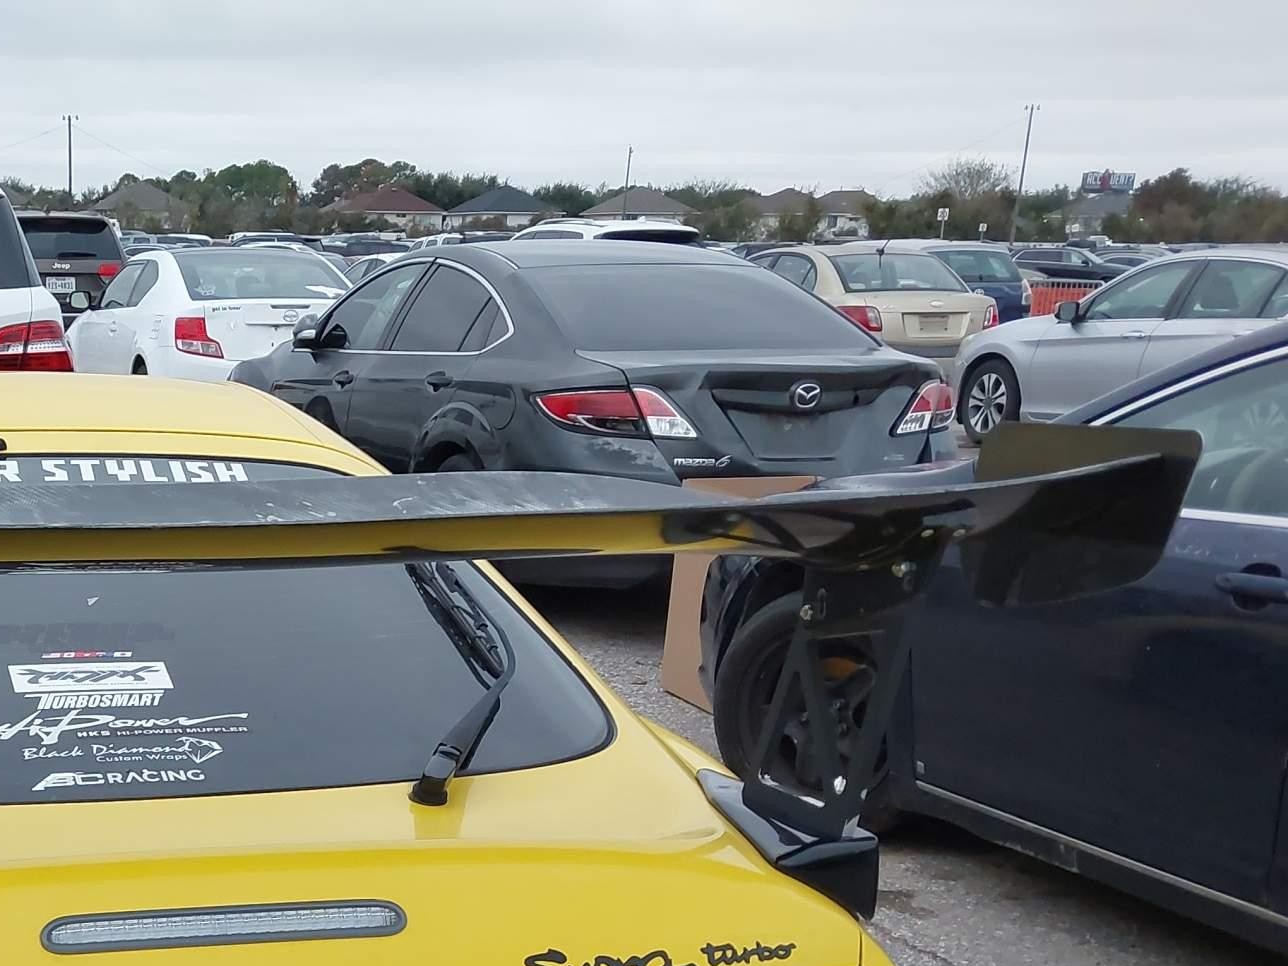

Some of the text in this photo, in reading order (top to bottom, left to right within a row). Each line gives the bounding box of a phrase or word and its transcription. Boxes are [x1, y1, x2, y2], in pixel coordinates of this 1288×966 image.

[51, 262, 71, 270] Jeep
[40, 458, 250, 482] STYLISH
[24, 690, 165, 711] TURBOSMART
[77, 726, 249, 738] HKS HI-POWER MUFFLER
[21, 739, 193, 760] Black Diamond
[95, 753, 189, 763] Custom Wraps
